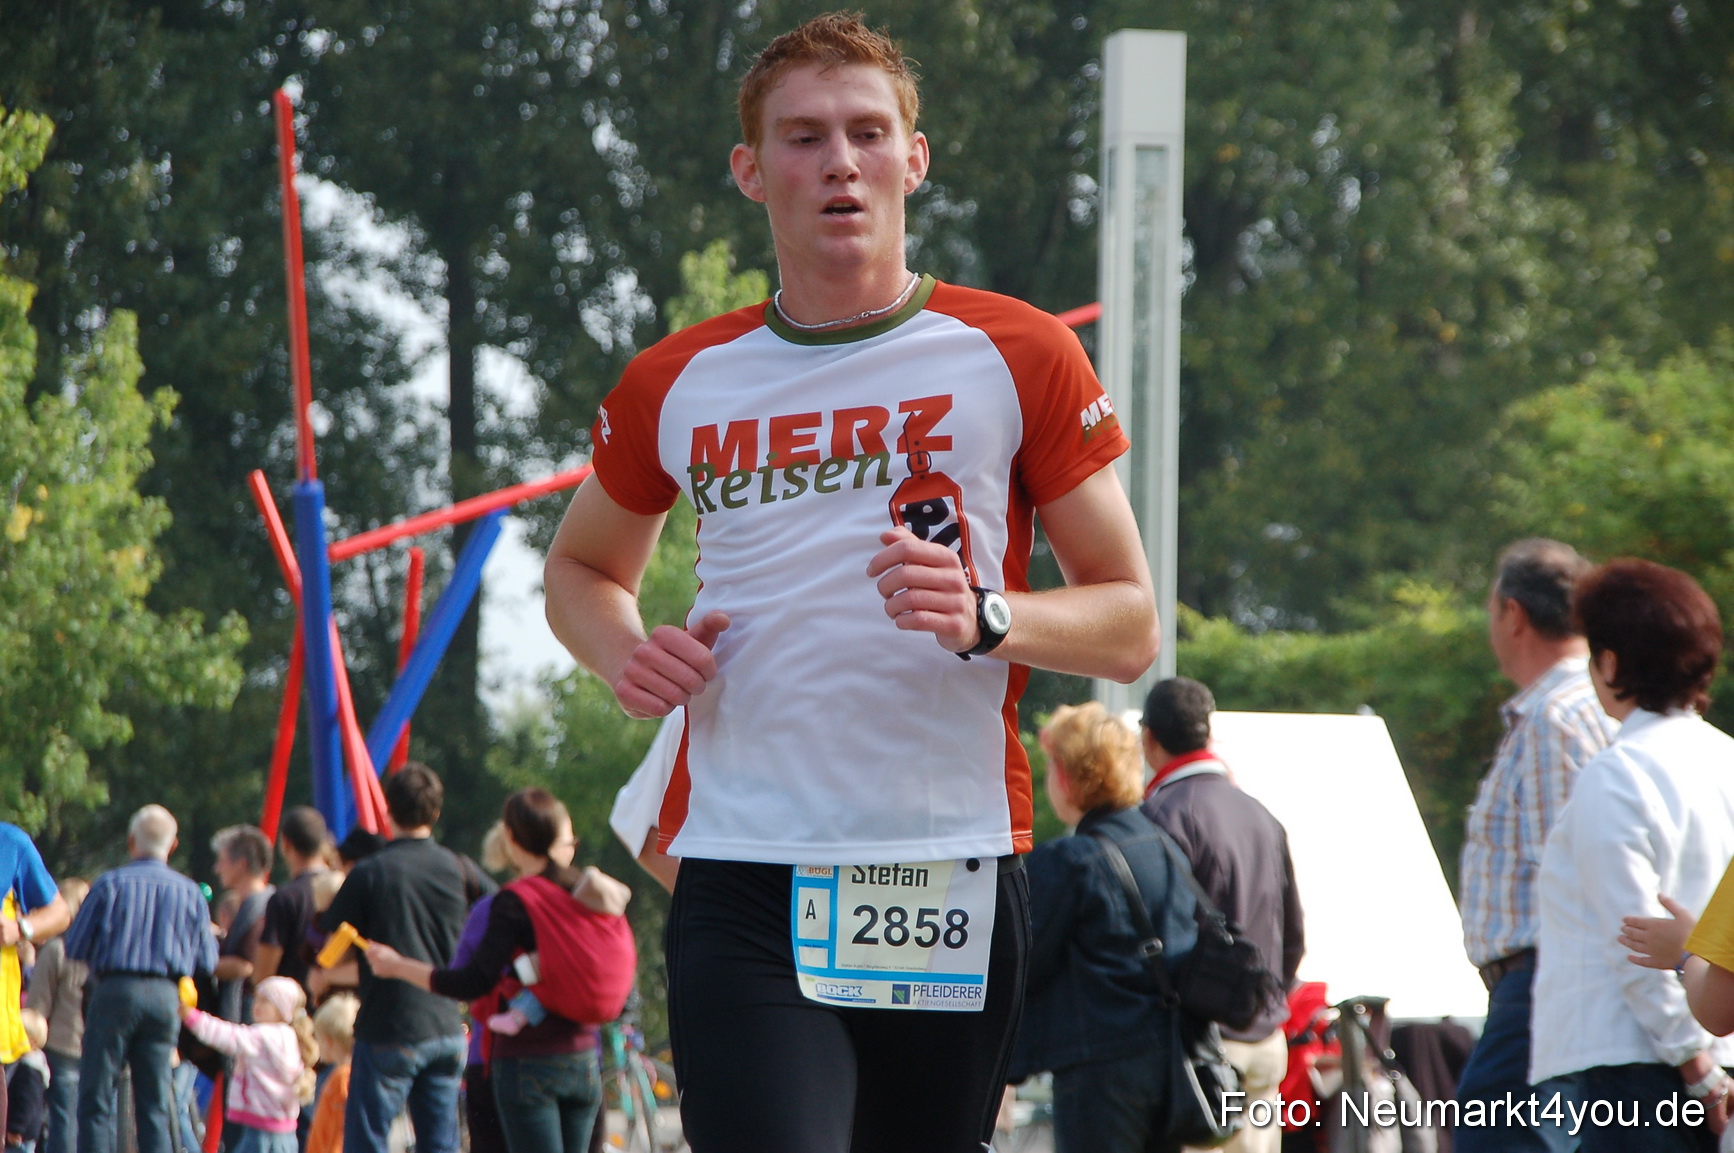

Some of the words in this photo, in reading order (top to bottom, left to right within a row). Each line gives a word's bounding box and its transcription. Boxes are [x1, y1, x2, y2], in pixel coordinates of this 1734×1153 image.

[690, 394, 953, 482] MERZ
[687, 449, 892, 515] Reisen
[851, 863, 929, 888] Stefan
[805, 898, 816, 920] A
[851, 904, 970, 950] 2858
[815, 983, 863, 998] BOCK
[913, 984, 982, 999] PFLEIDERER
